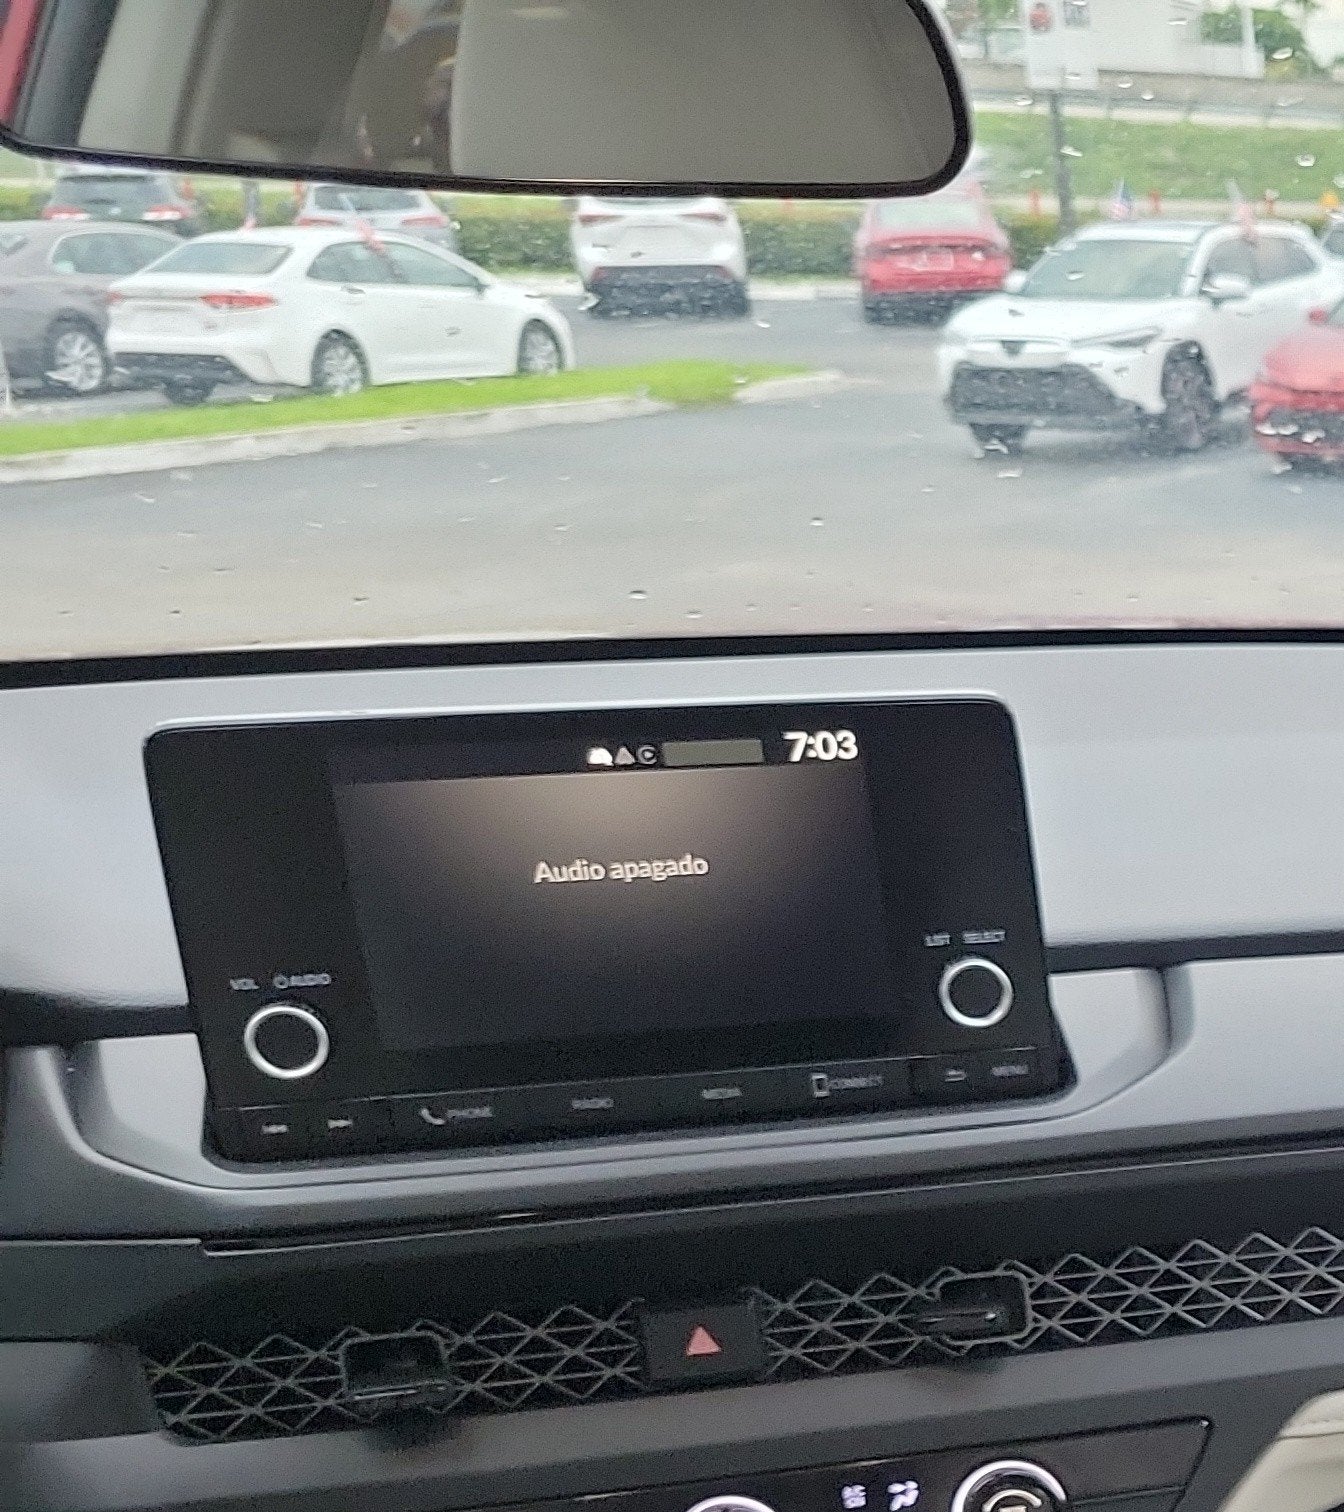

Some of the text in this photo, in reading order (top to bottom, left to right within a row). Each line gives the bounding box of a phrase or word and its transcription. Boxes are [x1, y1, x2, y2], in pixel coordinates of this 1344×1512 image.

[782, 730, 858, 763] 7:03
[533, 853, 709, 883] Audio apagado
[962, 931, 1006, 945] SELECT
[229, 973, 331, 991] VOL AUDIO
